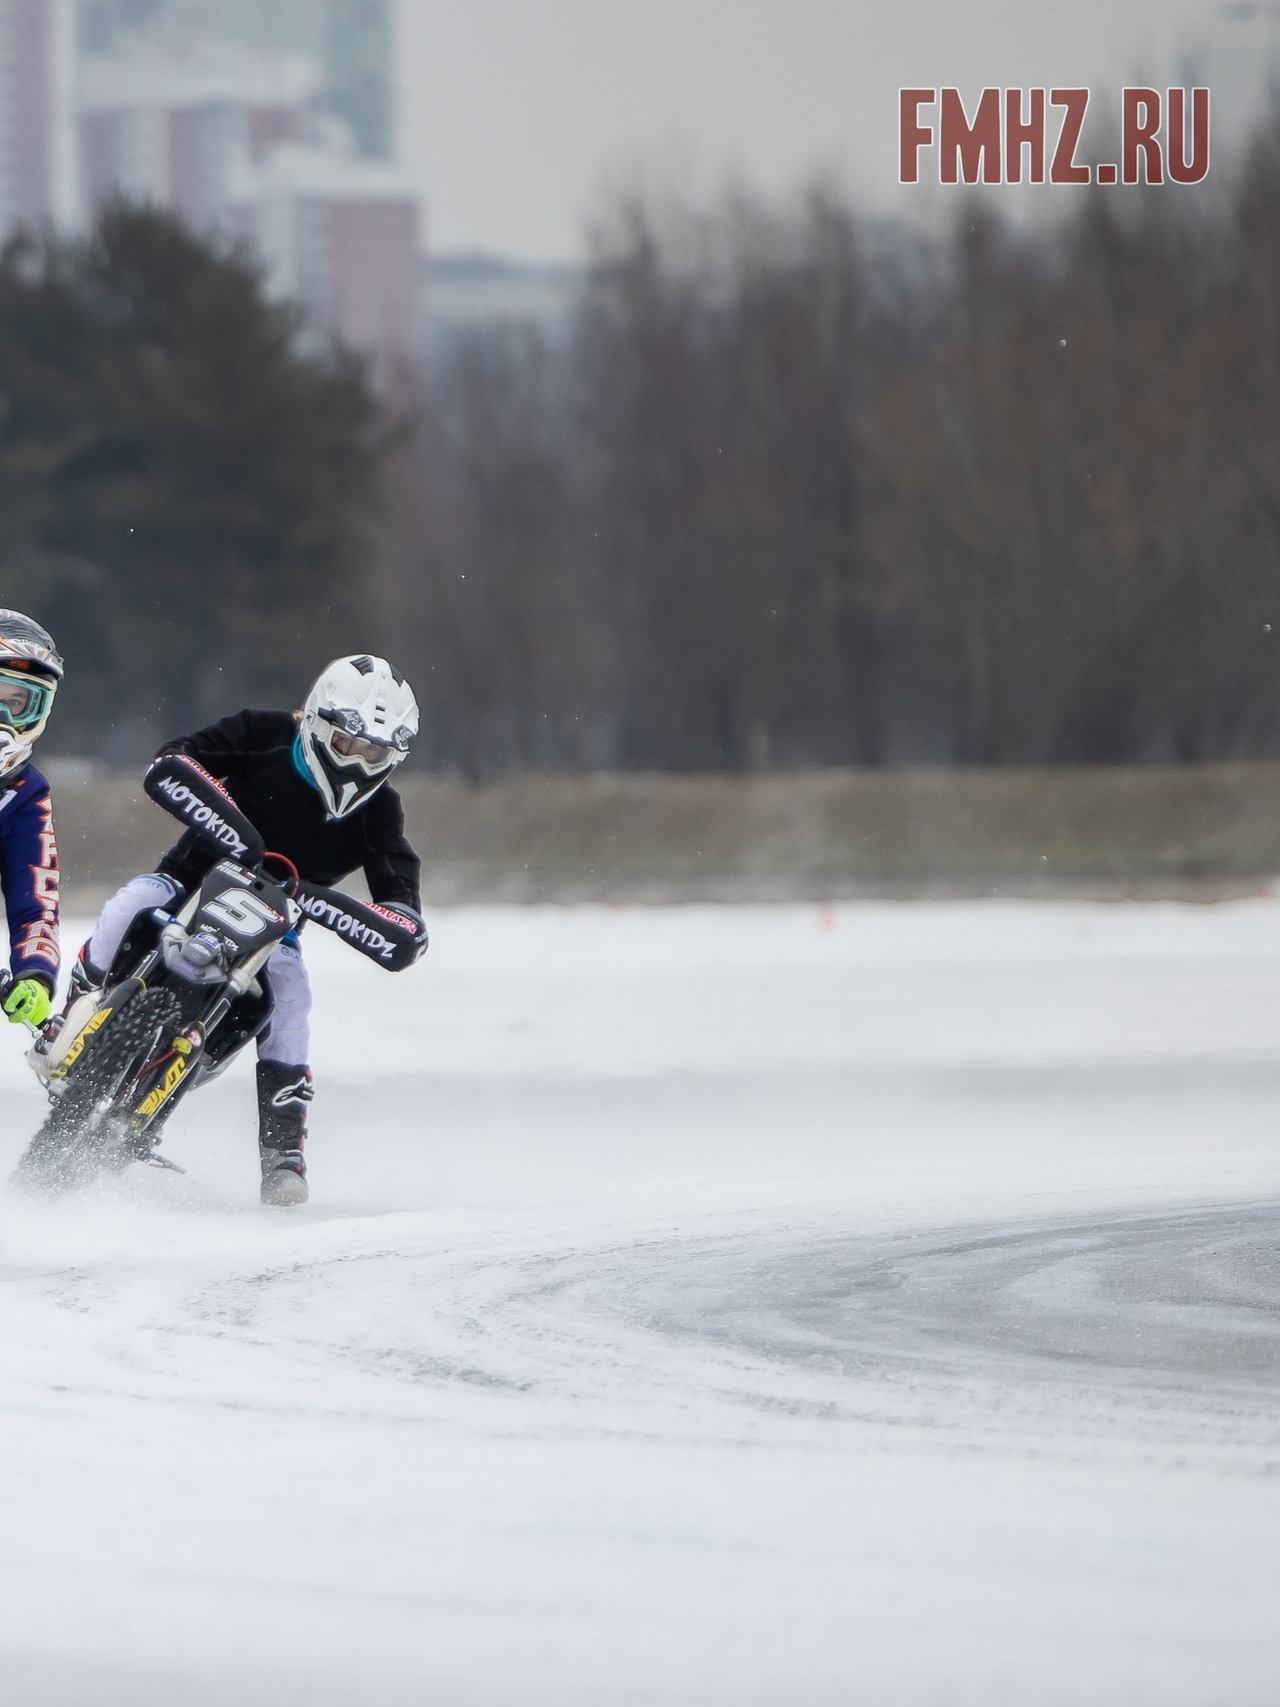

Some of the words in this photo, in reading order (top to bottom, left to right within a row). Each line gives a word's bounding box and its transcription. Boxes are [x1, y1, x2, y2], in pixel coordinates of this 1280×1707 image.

[158, 776, 249, 859] MOTOKIDZ
[202, 888, 280, 937] 5
[297, 893, 398, 959] MOTOKIDZ
